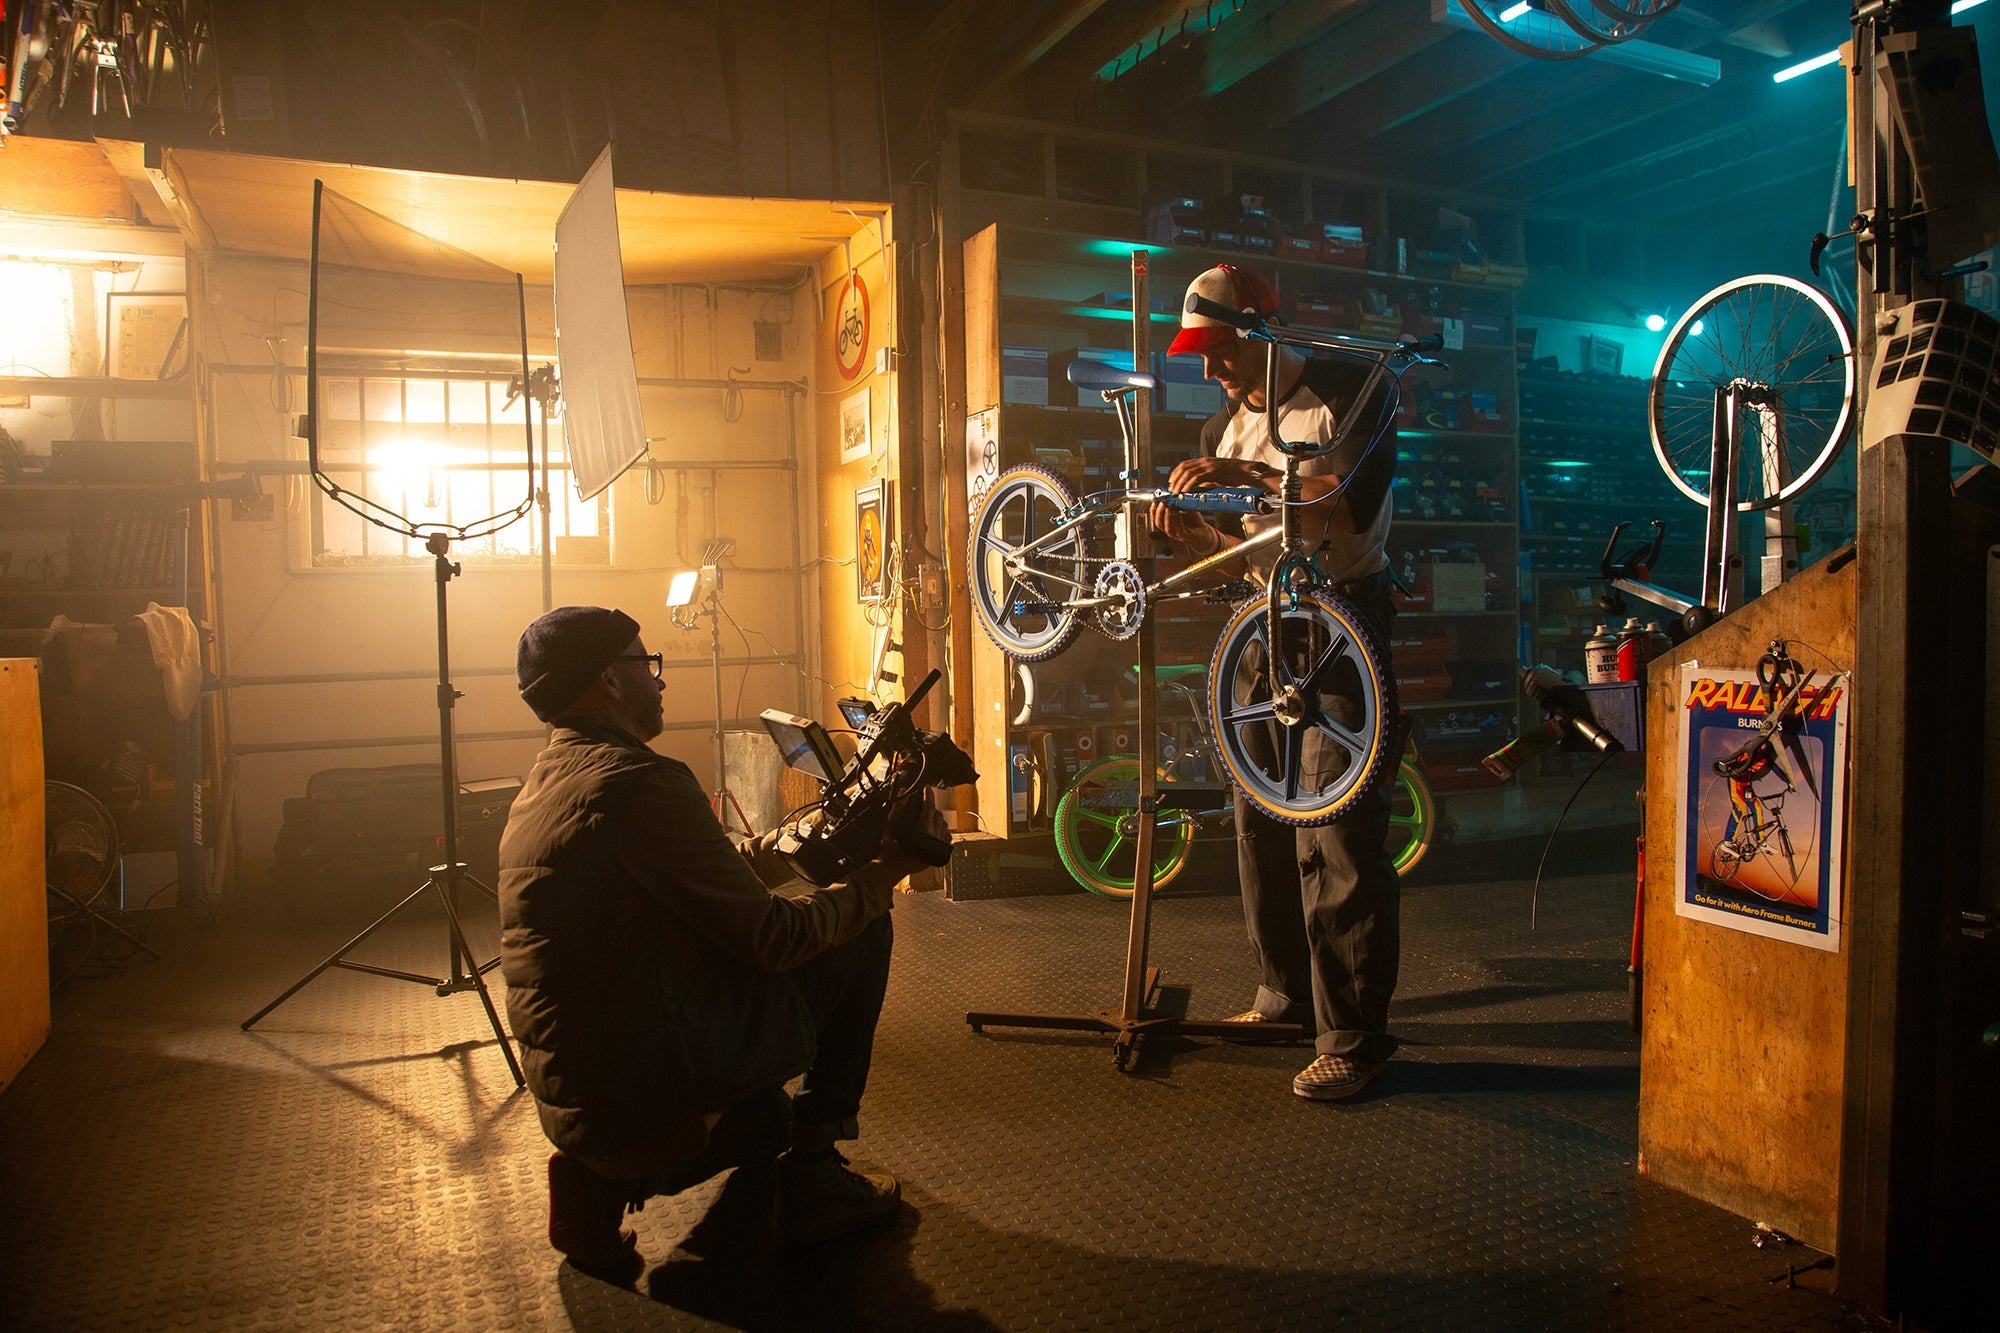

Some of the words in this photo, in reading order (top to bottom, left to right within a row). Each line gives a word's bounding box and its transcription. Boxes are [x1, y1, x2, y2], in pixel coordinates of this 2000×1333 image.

[1597, 663, 1618, 673] BUS
[1602, 655, 1618, 663] RU
[1738, 717, 1783, 731] BURNS
[193, 782, 202, 814] Park
[193, 815, 203, 847] Tool
[1695, 893, 1706, 903] Go
[1706, 896, 1718, 906] for
[1718, 898, 1723, 907] it
[1723, 899, 1741, 911] with
[1741, 905, 1760, 916] Aero
[1760, 909, 1784, 921] Frame
[1785, 914, 1817, 929] Burners
